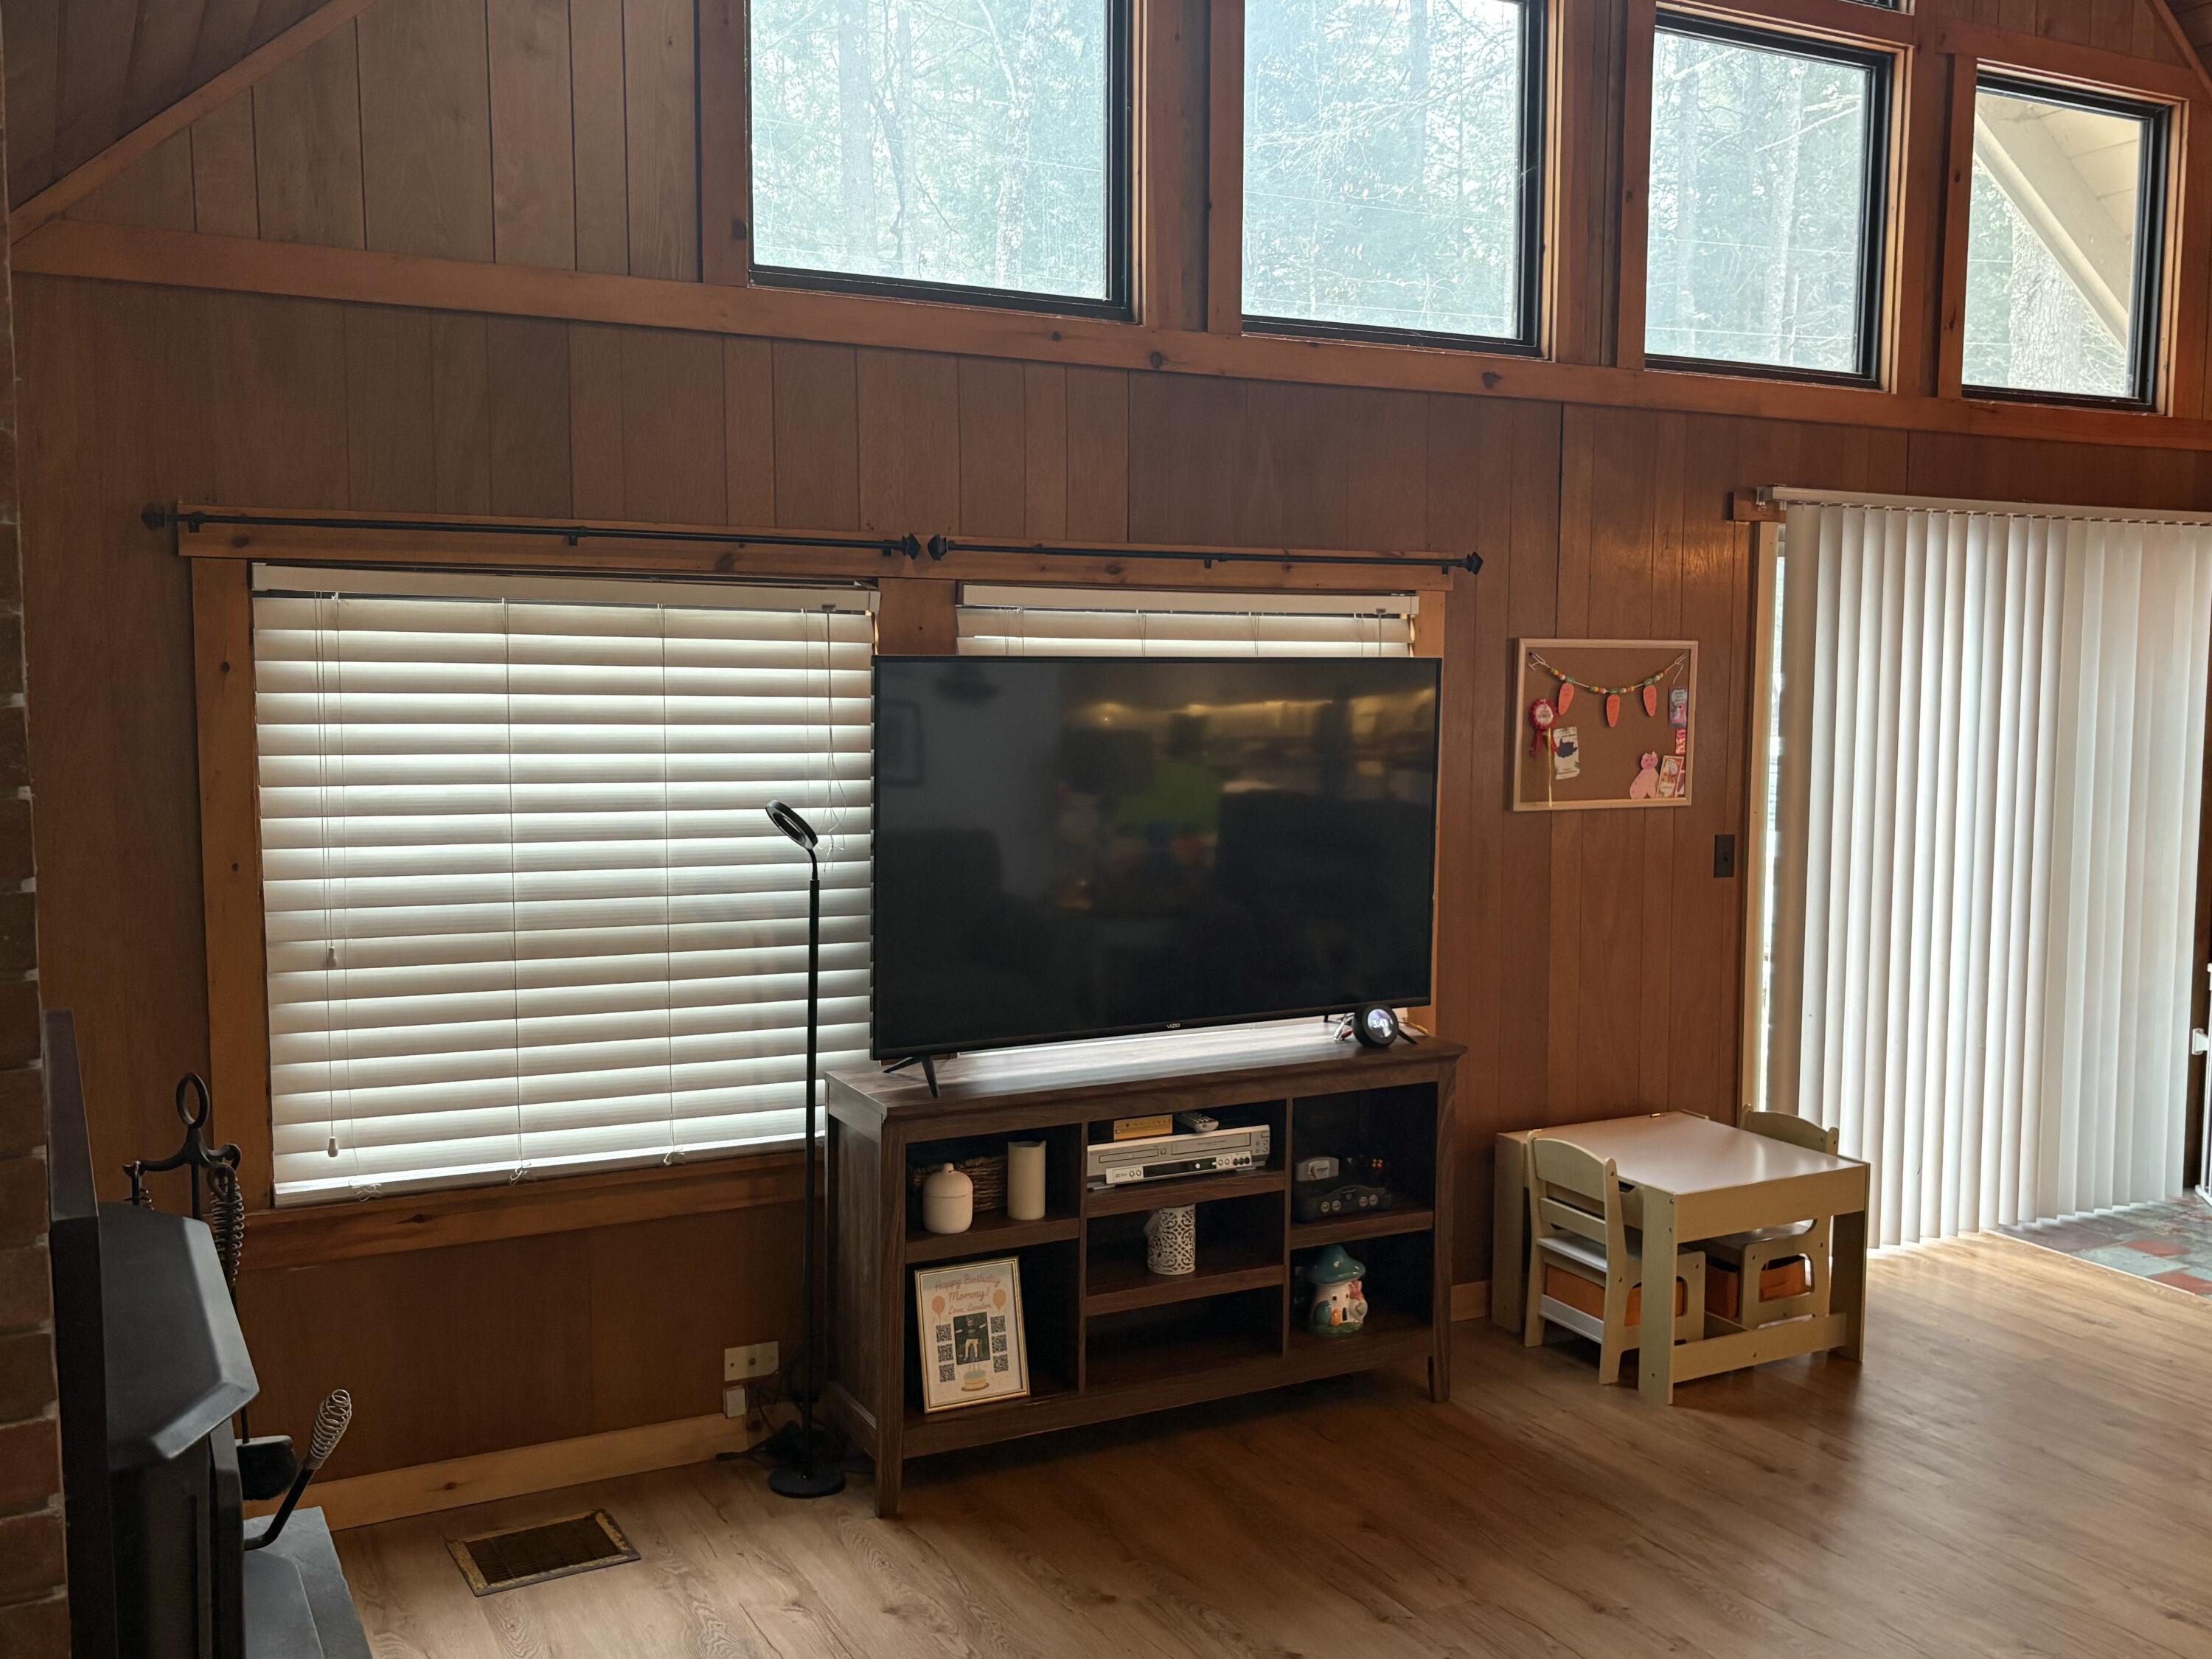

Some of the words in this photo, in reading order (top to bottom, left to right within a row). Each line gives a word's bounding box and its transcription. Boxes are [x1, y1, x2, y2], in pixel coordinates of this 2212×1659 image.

[935, 1279, 962, 1292] Happy
[964, 1273, 1001, 1287] Birthday
[948, 1286, 991, 1302] Mommy!
